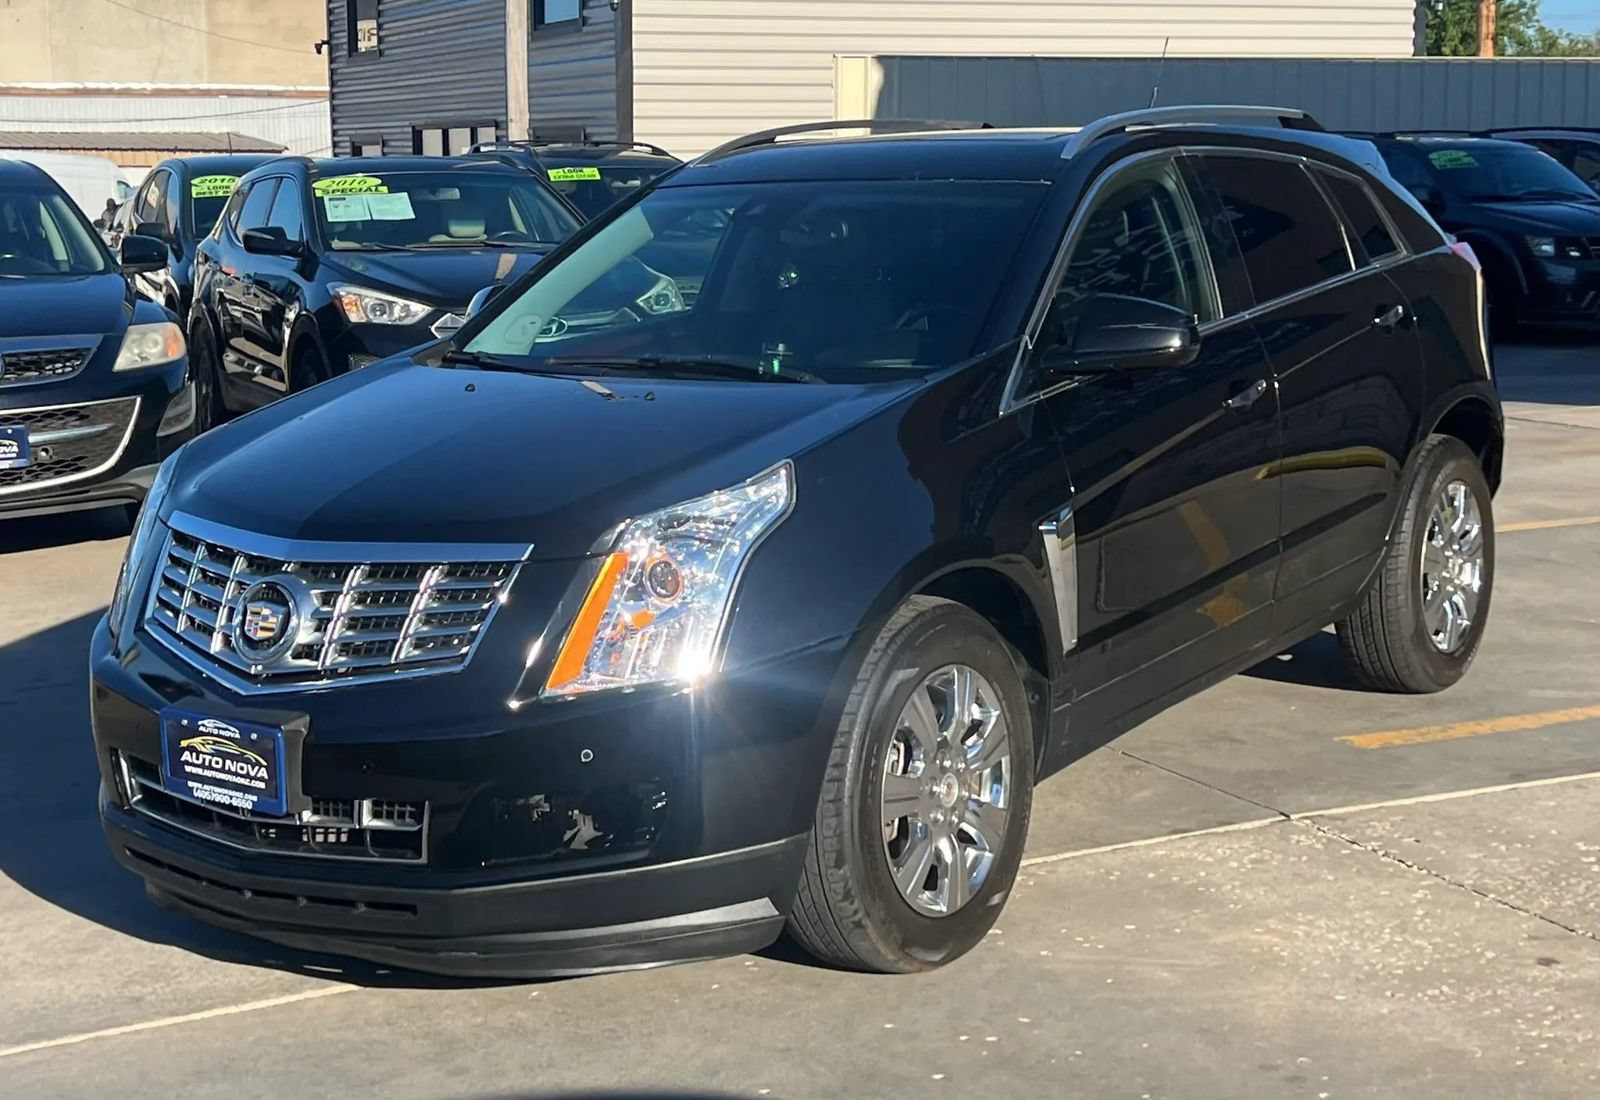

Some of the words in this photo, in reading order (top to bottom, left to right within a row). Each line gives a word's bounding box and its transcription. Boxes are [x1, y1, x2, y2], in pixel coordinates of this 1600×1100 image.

[325, 179, 368, 188] 2016
[321, 186, 384, 194] SPECIAL
[198, 725, 219, 735] AUTO
[219, 730, 241, 739] NOVA
[180, 750, 223, 769] AUTO
[224, 760, 269, 780] NOVA
